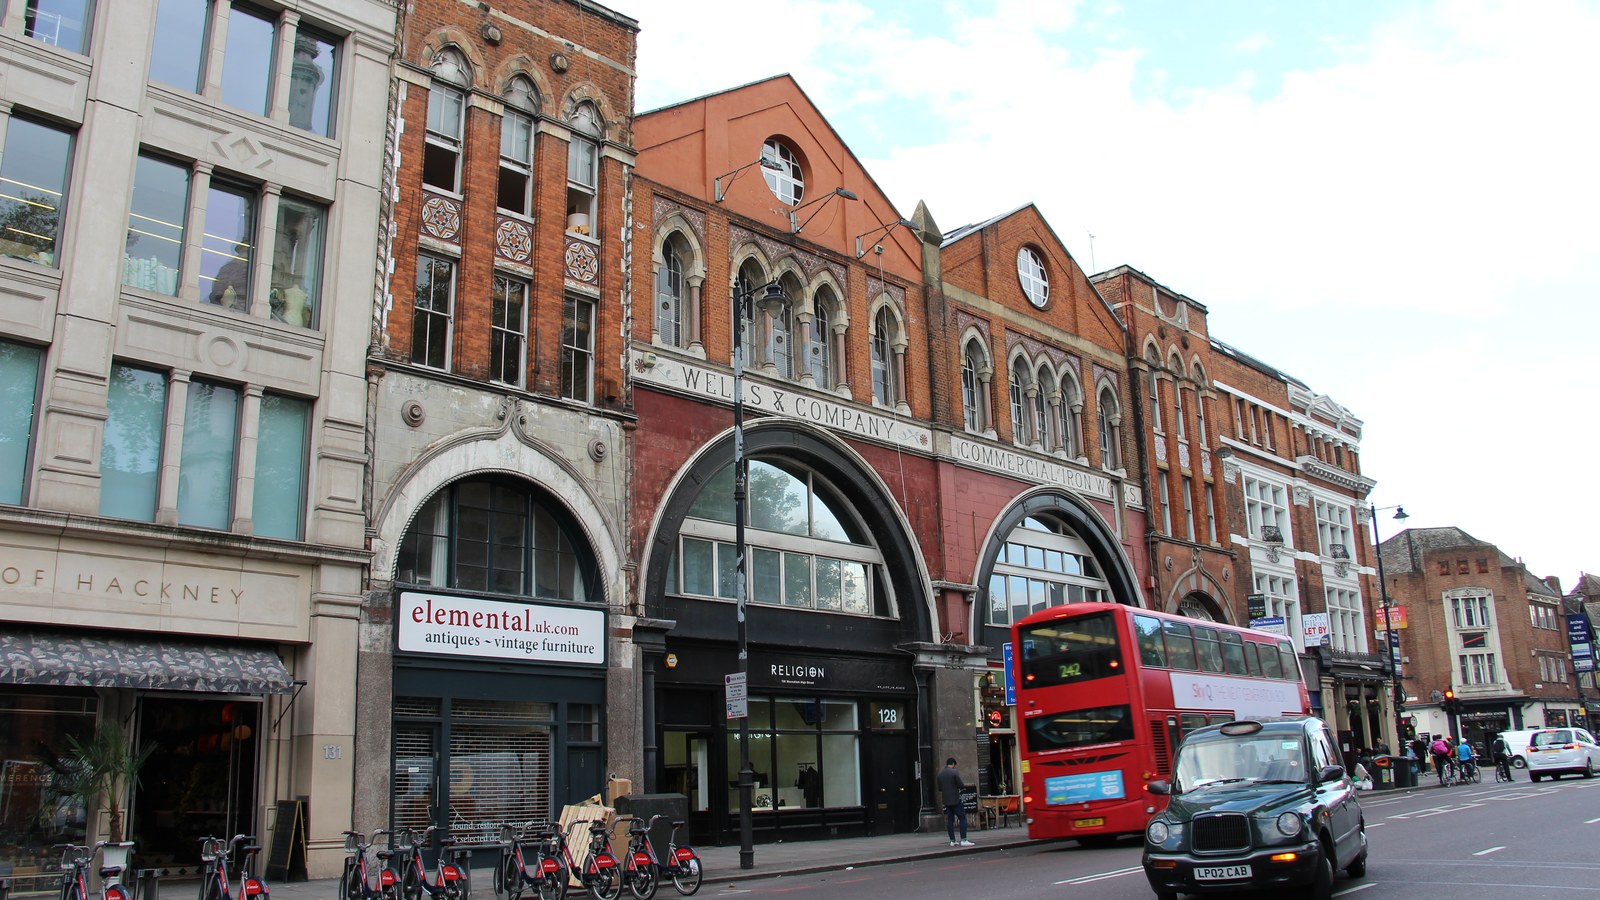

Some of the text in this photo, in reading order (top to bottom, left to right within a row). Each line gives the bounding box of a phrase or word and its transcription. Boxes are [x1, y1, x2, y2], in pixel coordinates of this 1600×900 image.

[682, 366, 762, 405] WELS
[795, 397, 894, 440] COMPANY
[960, 441, 1058, 482] COMMERCIAL
[1061, 466, 1092, 490] IRON
[2, 566, 244, 605] OF HACKNEY
[412, 599, 579, 636] elemental.uk.com
[1304, 626, 1327, 635] LET BY
[425, 630, 595, 654] antiques vintage furniture
[771, 664, 825, 678] RELIGION
[1060, 663, 1082, 677] 242
[879, 708, 897, 723] 128
[323, 745, 342, 760] 131
[1197, 866, 1248, 878] LP02 CAB
